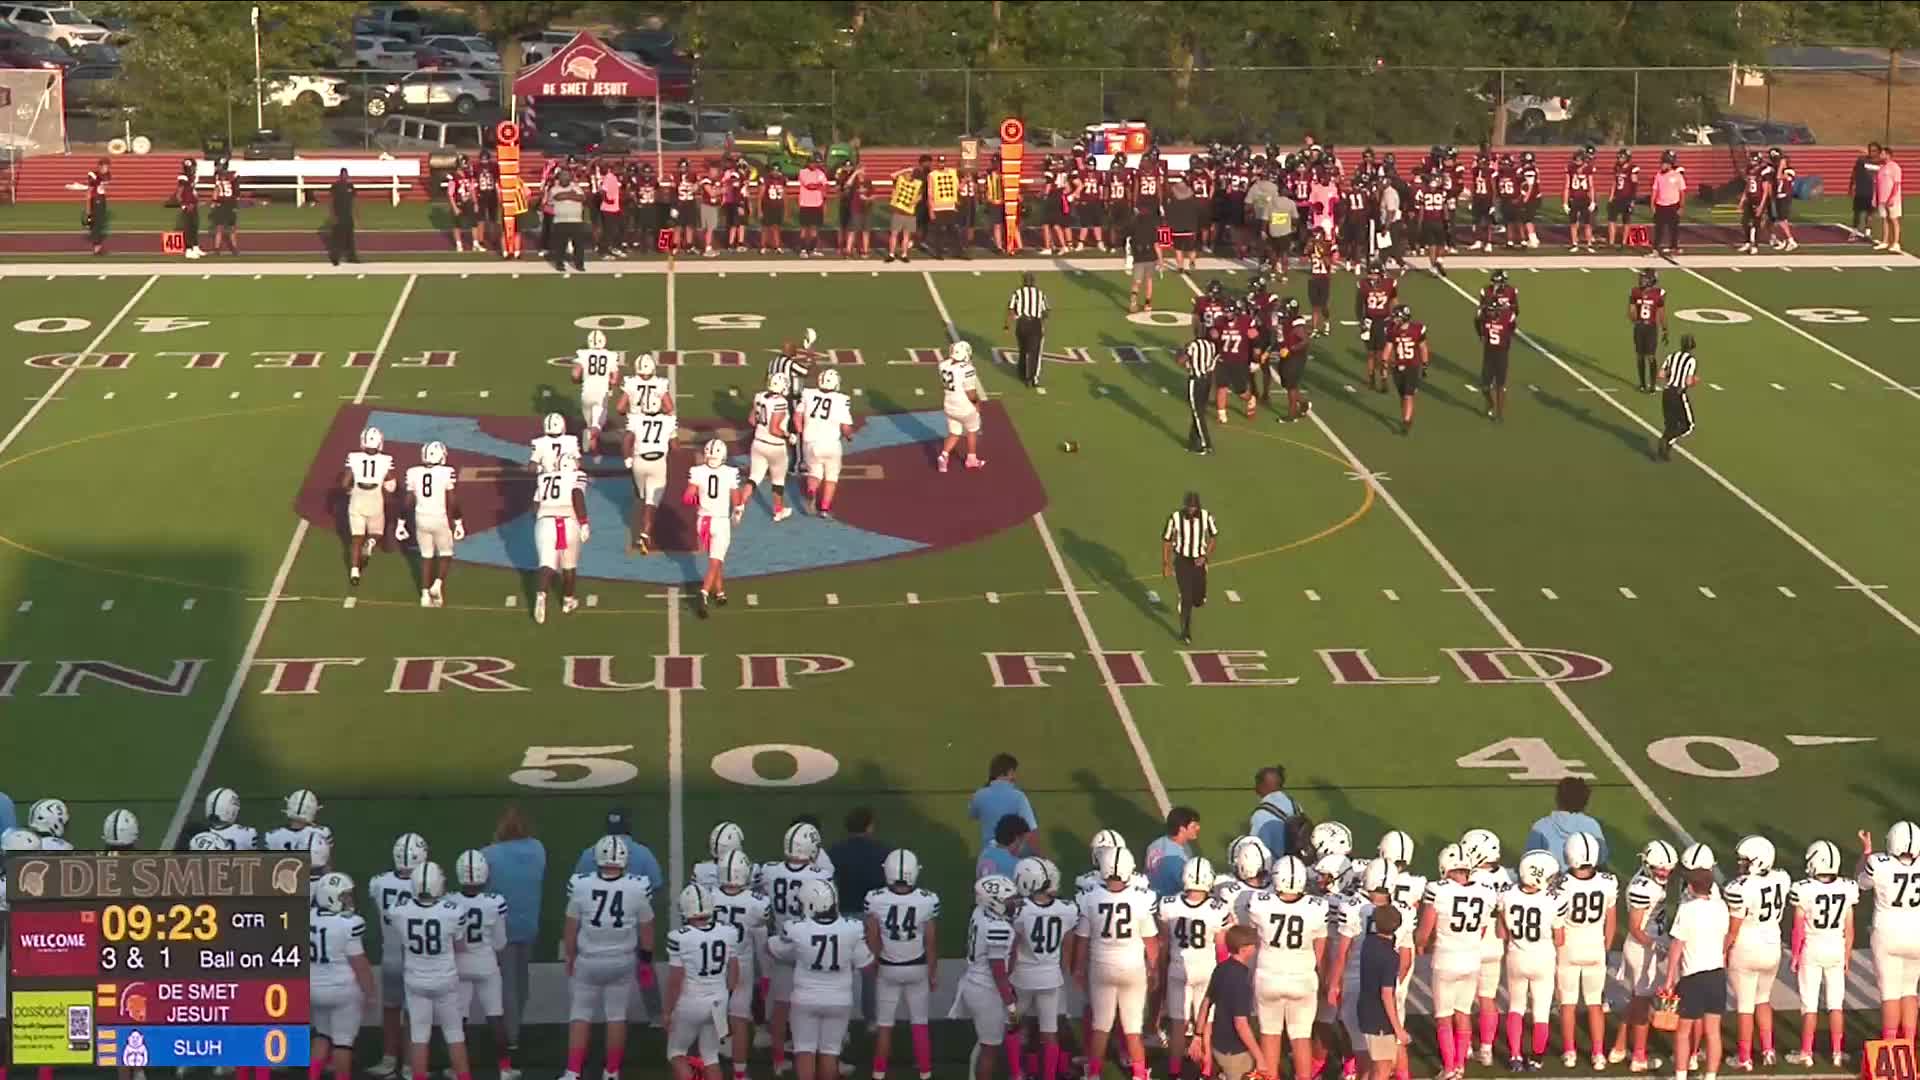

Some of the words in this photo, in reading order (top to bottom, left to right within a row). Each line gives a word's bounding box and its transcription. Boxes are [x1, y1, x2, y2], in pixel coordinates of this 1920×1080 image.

[543, 83, 556, 95] DE
[561, 82, 587, 95] SMET
[592, 82, 628, 95] JESUIT
[165, 234, 182, 250] 40
[587, 354, 608, 377] 88
[810, 396, 832, 420] 79
[642, 421, 663, 444] 77
[360, 459, 377, 479] 11
[421, 473, 432, 498] 8
[707, 474, 720, 500] 0
[542, 475, 562, 501] 76
[980, 647, 1613, 689] FIELD
[509, 744, 840, 789] 50
[1456, 736, 1780, 781] 40
[591, 888, 625, 929] 74
[1098, 902, 1133, 940] 72
[1449, 896, 1484, 933] 53
[1570, 891, 1603, 924] 89
[1759, 884, 1783, 923] 54
[1814, 893, 1846, 930] 37
[407, 918, 442, 956] 58
[884, 904, 918, 941] 44
[1030, 915, 1063, 955] 40
[1173, 916, 1207, 951] 48
[1269, 912, 1304, 951] 78
[1508, 904, 1542, 943] 38
[697, 938, 728, 977] 19
[810, 933, 840, 972] 71
